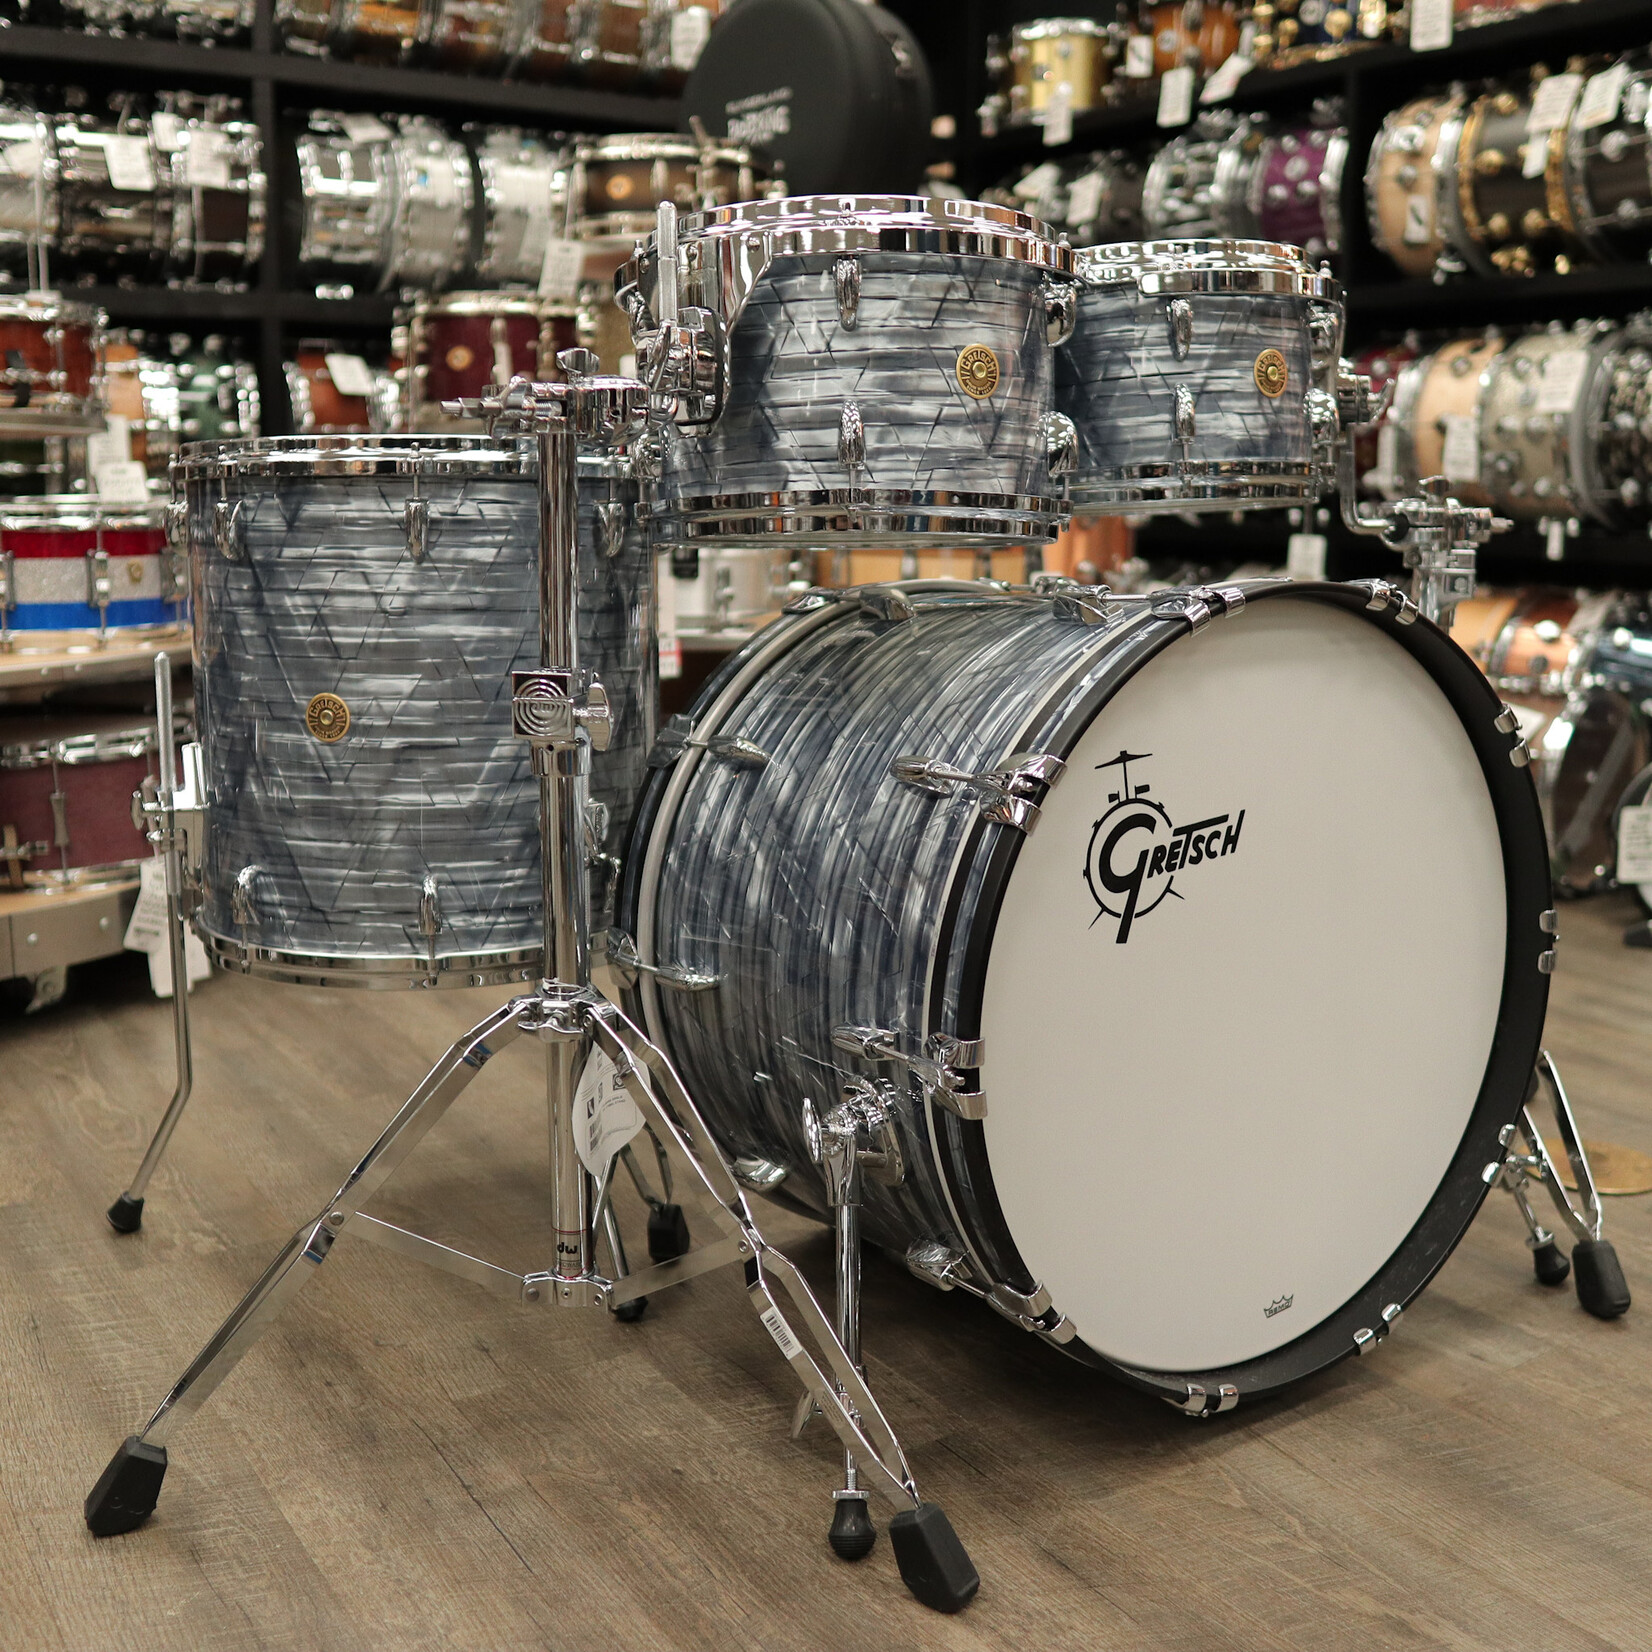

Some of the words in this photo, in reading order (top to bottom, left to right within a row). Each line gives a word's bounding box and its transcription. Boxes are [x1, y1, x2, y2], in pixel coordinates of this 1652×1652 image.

[960, 348, 996, 371] GRETSCH
[557, 1242, 578, 1254] dw
[1268, 1301, 1290, 1315] REMO
